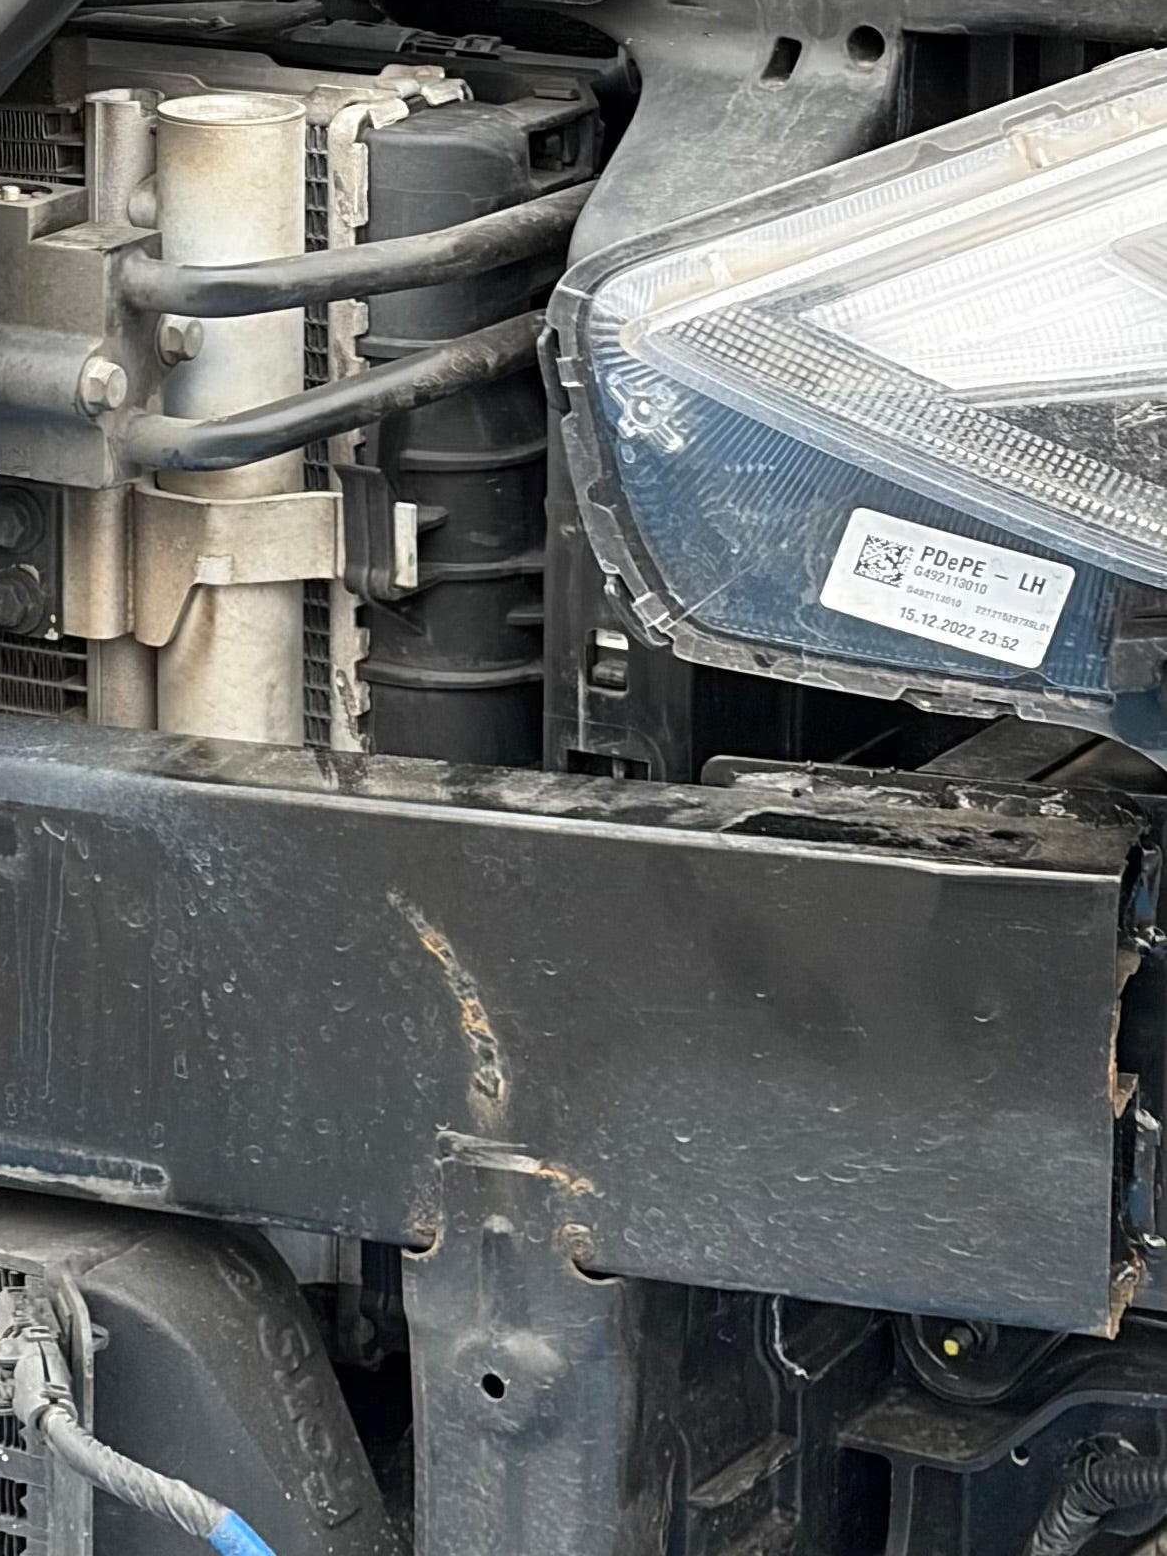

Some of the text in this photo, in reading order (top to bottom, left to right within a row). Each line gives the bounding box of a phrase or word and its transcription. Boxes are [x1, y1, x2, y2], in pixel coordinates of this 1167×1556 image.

[913, 565, 988, 595] G492113010
[919, 545, 987, 578] PDePE
[1018, 572, 1047, 595] LH
[899, 606, 1020, 652] 15.12.2022 23:52
